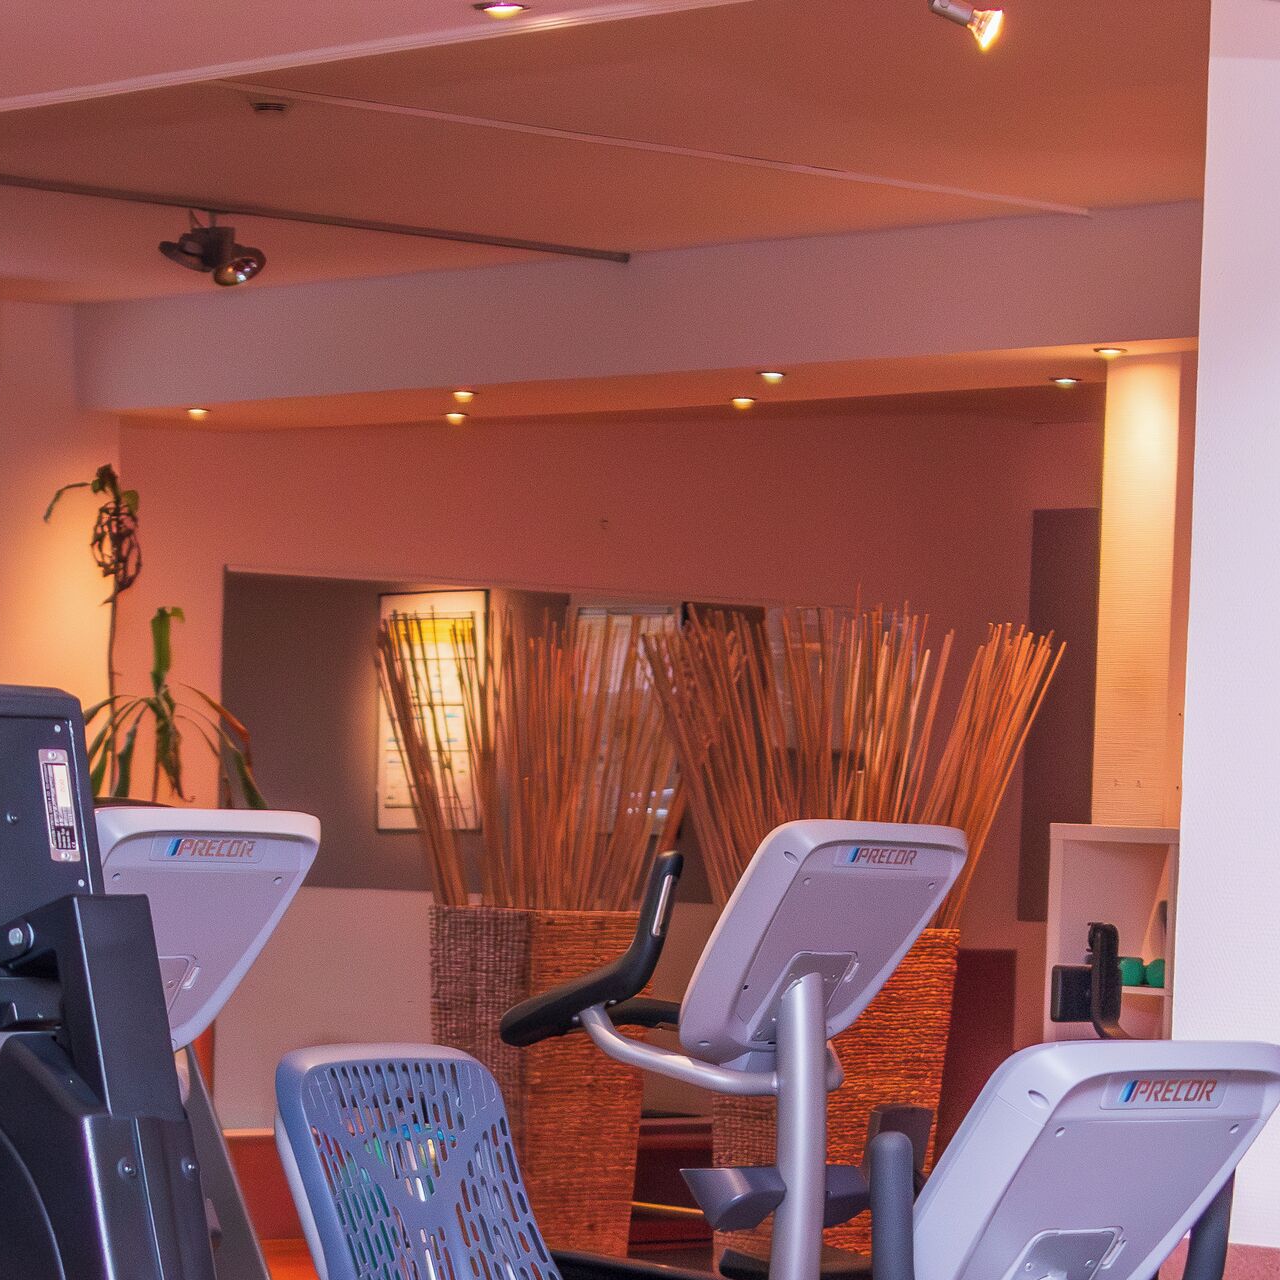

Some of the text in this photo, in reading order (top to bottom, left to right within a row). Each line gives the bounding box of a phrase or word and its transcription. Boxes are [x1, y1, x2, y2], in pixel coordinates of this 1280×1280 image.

[176, 839, 257, 858] PRECOR
[855, 847, 918, 866] PRECOR
[1130, 1079, 1218, 1102] PRECOR
